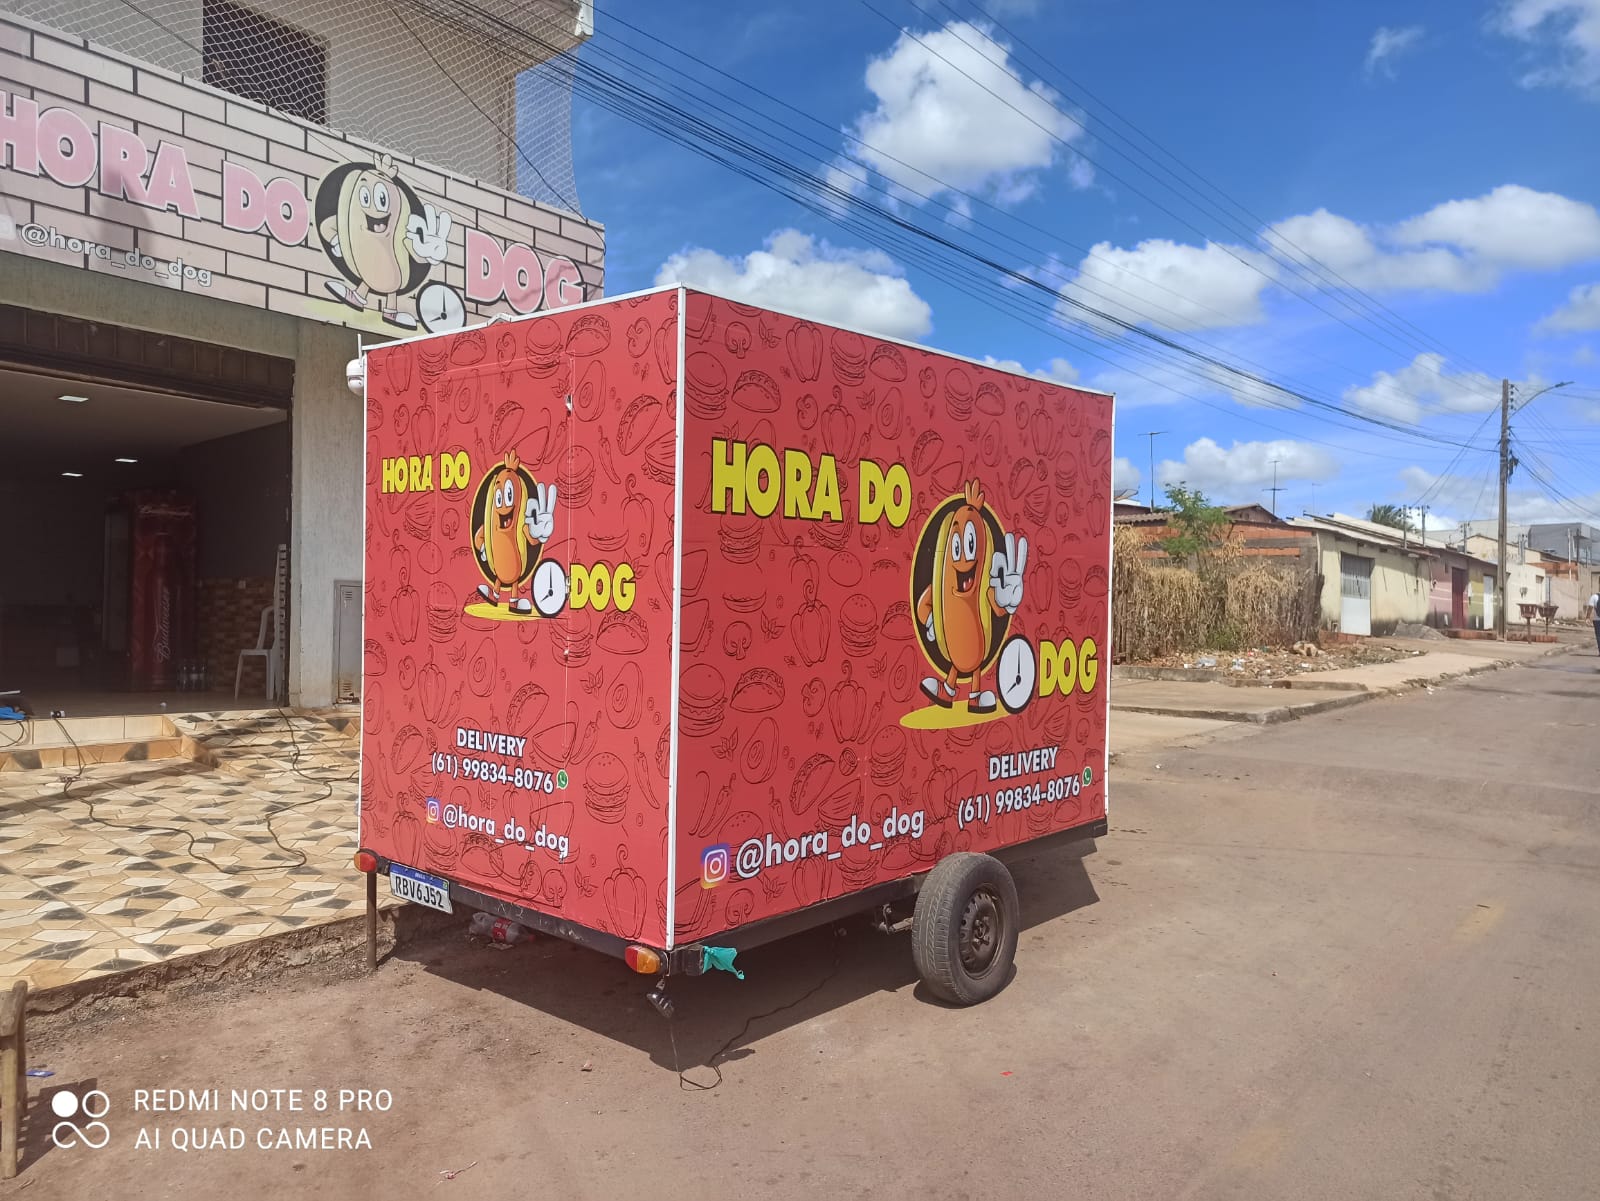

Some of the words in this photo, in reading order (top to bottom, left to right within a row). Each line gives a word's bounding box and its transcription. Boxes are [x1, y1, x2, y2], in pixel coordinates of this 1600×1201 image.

[0, 90, 201, 222] HORA
[221, 159, 310, 246] DO
[20, 223, 212, 287] @hora_do_dog
[464, 227, 587, 316] DOG
[381, 454, 434, 494] HORA
[440, 450, 471, 490] DO
[711, 437, 844, 522] HORA
[858, 458, 912, 528] DO
[569, 562, 637, 612] DOG
[1038, 636, 1098, 698] DOG
[456, 727, 527, 758] DELIVERY
[988, 747, 1059, 781] DELIVERY
[431, 752, 458, 779] (61)
[462, 757, 554, 794] 99834-8076
[957, 794, 991, 830] (61)
[994, 775, 1081, 815] 99834-8076
[443, 803, 570, 859] @hora_do_dog
[735, 807, 926, 879] @hora_do_dog
[395, 875, 444, 909] RBV6J52
